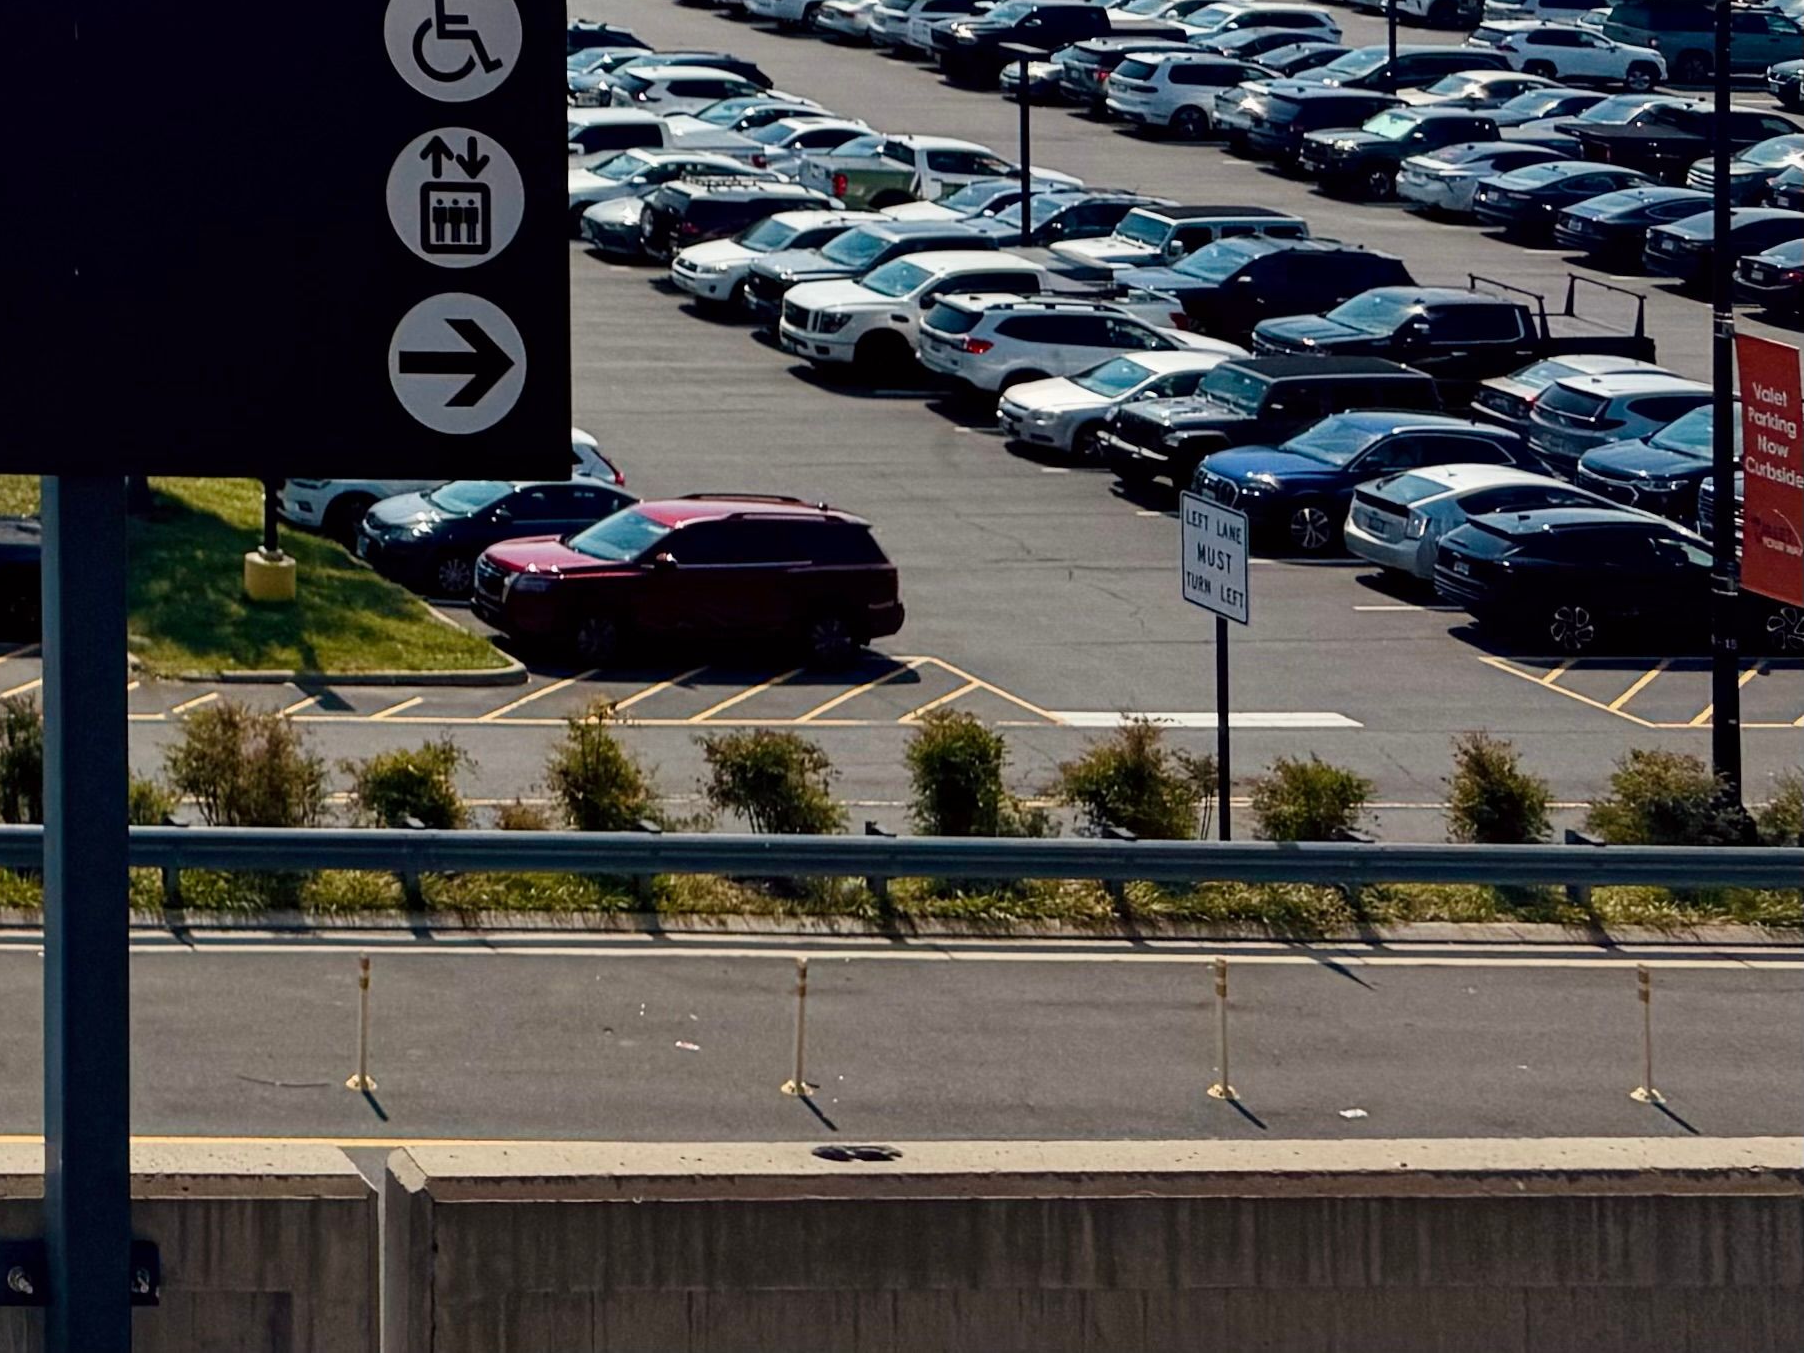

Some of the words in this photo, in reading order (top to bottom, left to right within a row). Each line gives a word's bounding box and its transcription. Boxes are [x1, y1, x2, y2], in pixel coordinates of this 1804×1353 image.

[1752, 381, 1787, 407] Valet
[1748, 406, 1797, 439] Parking
[1757, 433, 1789, 458] Now
[1745, 456, 1804, 489] Curbside
[1186, 508, 1209, 532] LEFT
[1216, 519, 1242, 545] LANE
[1197, 542, 1231, 574] MUST
[1186, 571, 1211, 596] TURN
[1220, 584, 1243, 609] LEFT
